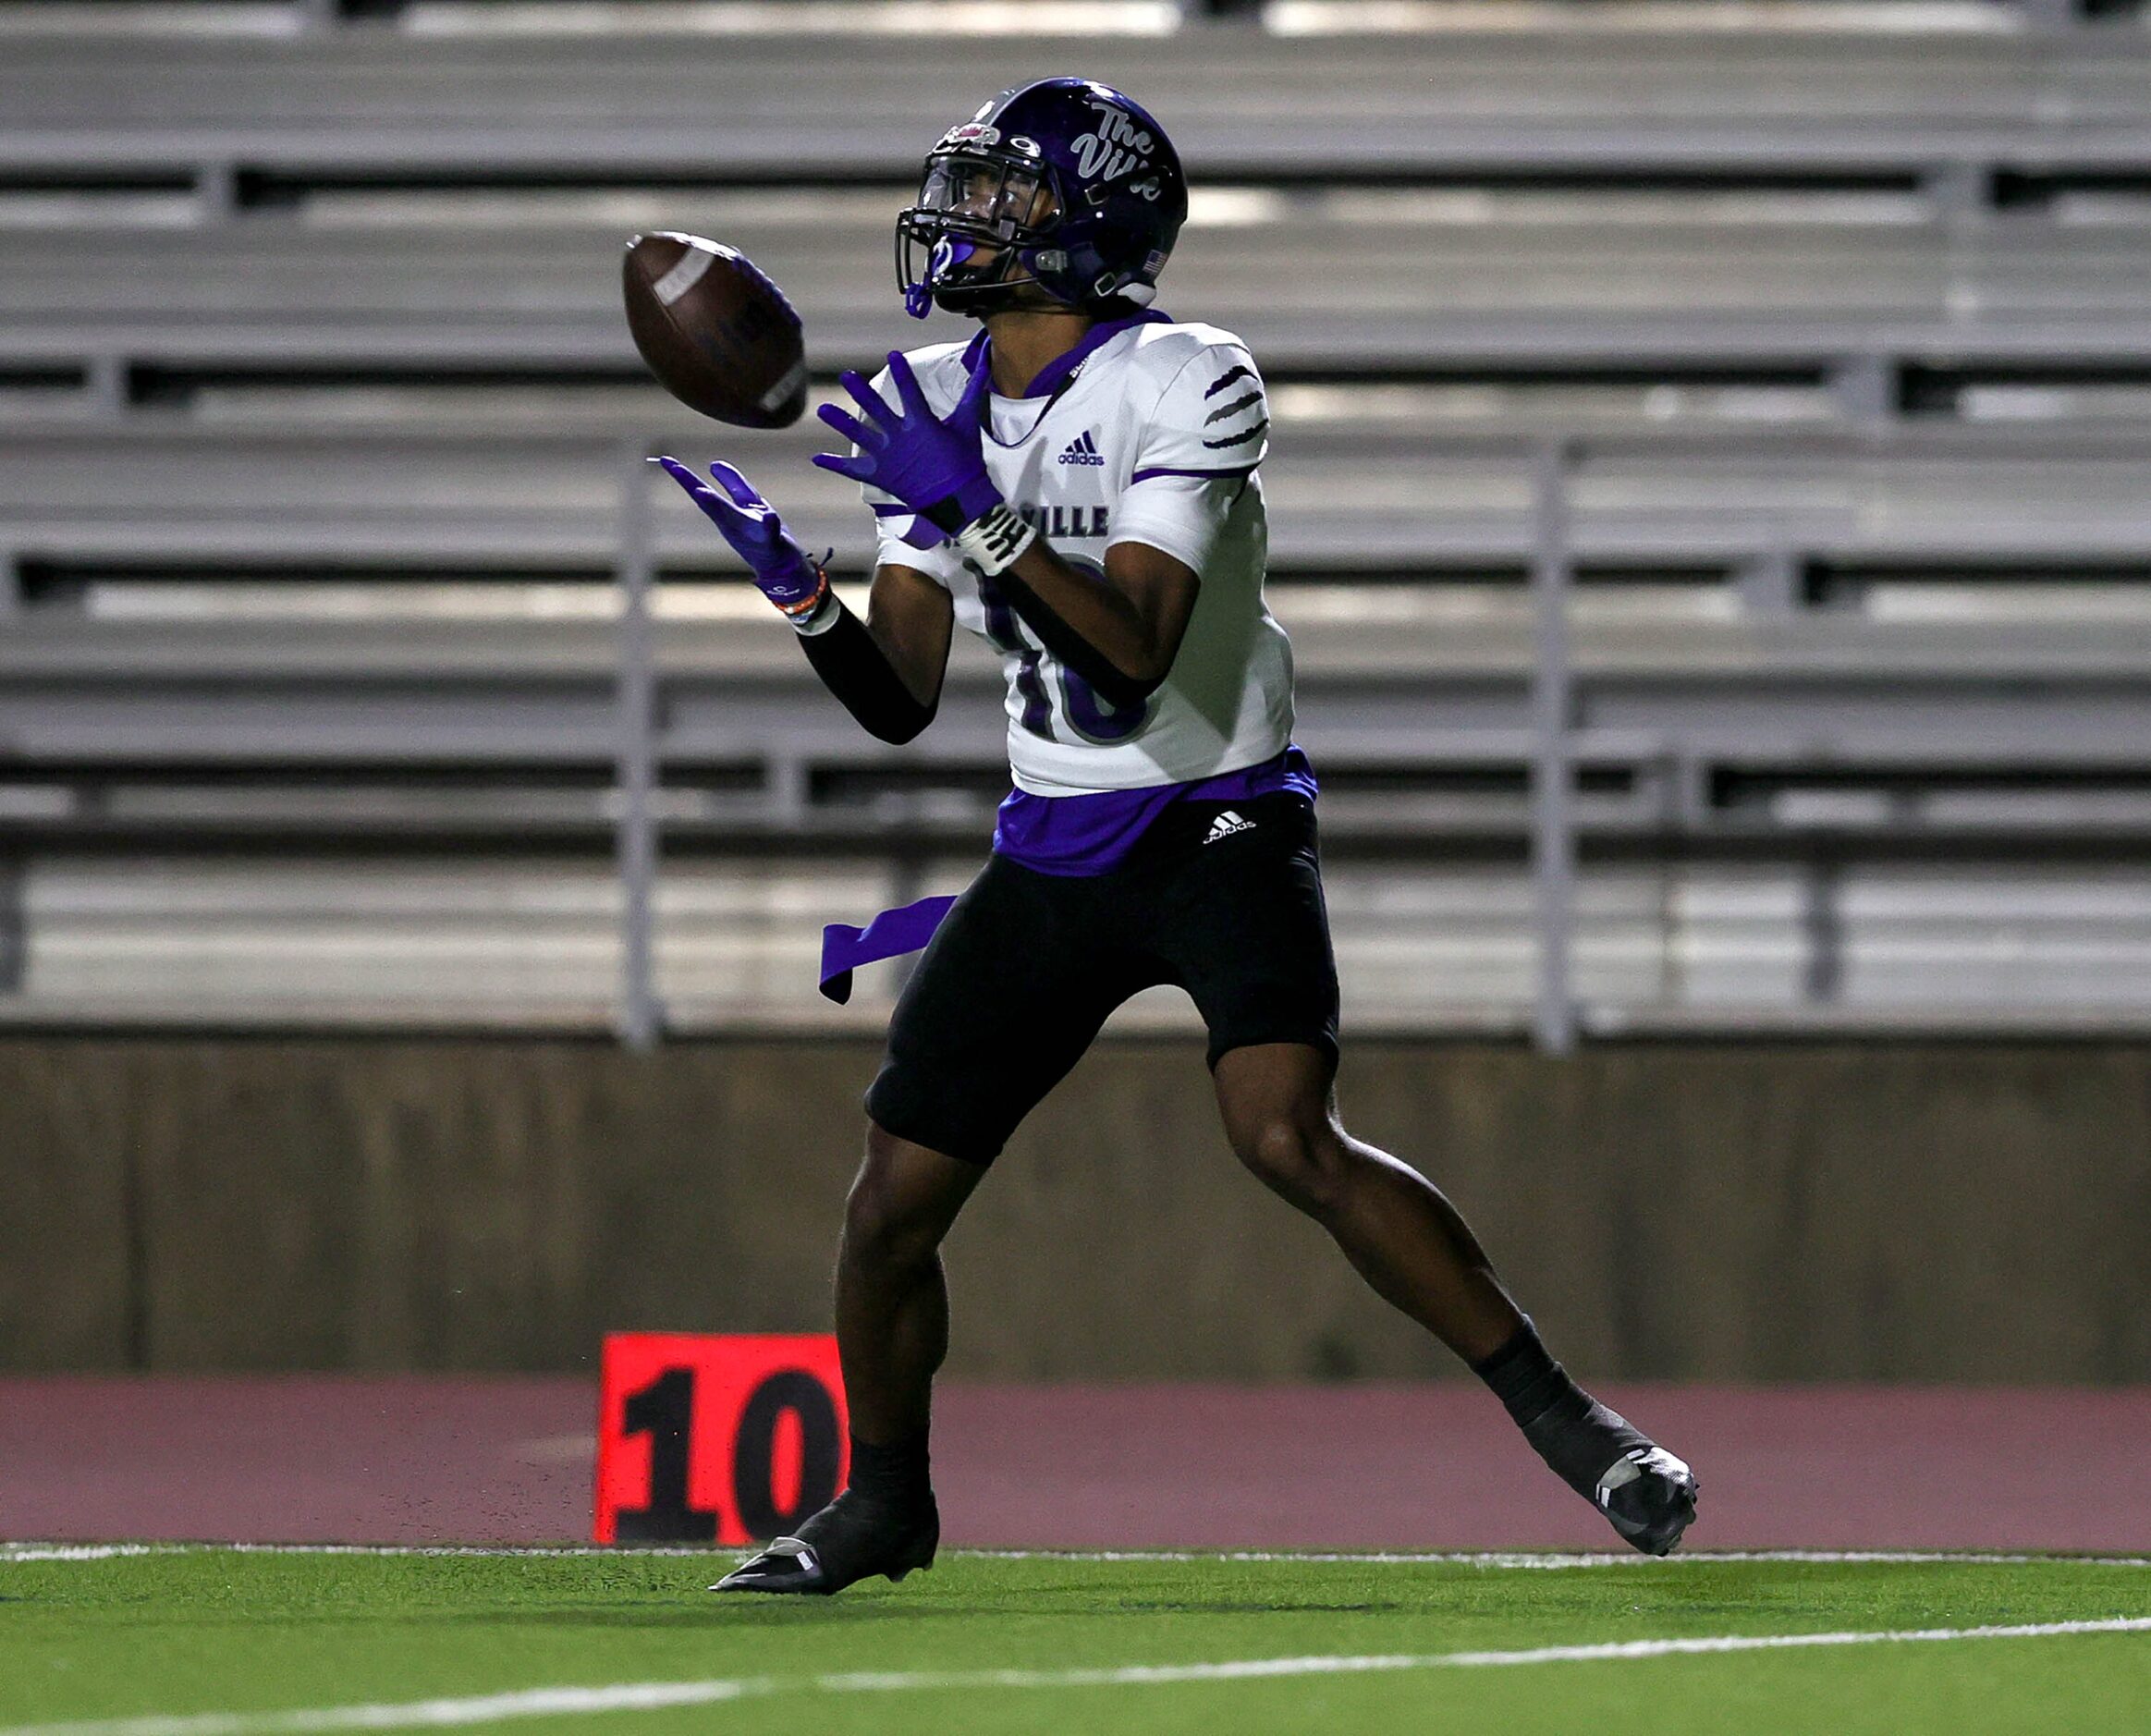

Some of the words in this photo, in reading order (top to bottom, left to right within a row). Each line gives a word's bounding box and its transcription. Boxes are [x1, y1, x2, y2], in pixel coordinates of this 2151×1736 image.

[1091, 102, 1155, 154] The
[1057, 451, 1105, 466] adidas
[1203, 820, 1257, 845] adidas
[615, 1366, 840, 1542] 10
